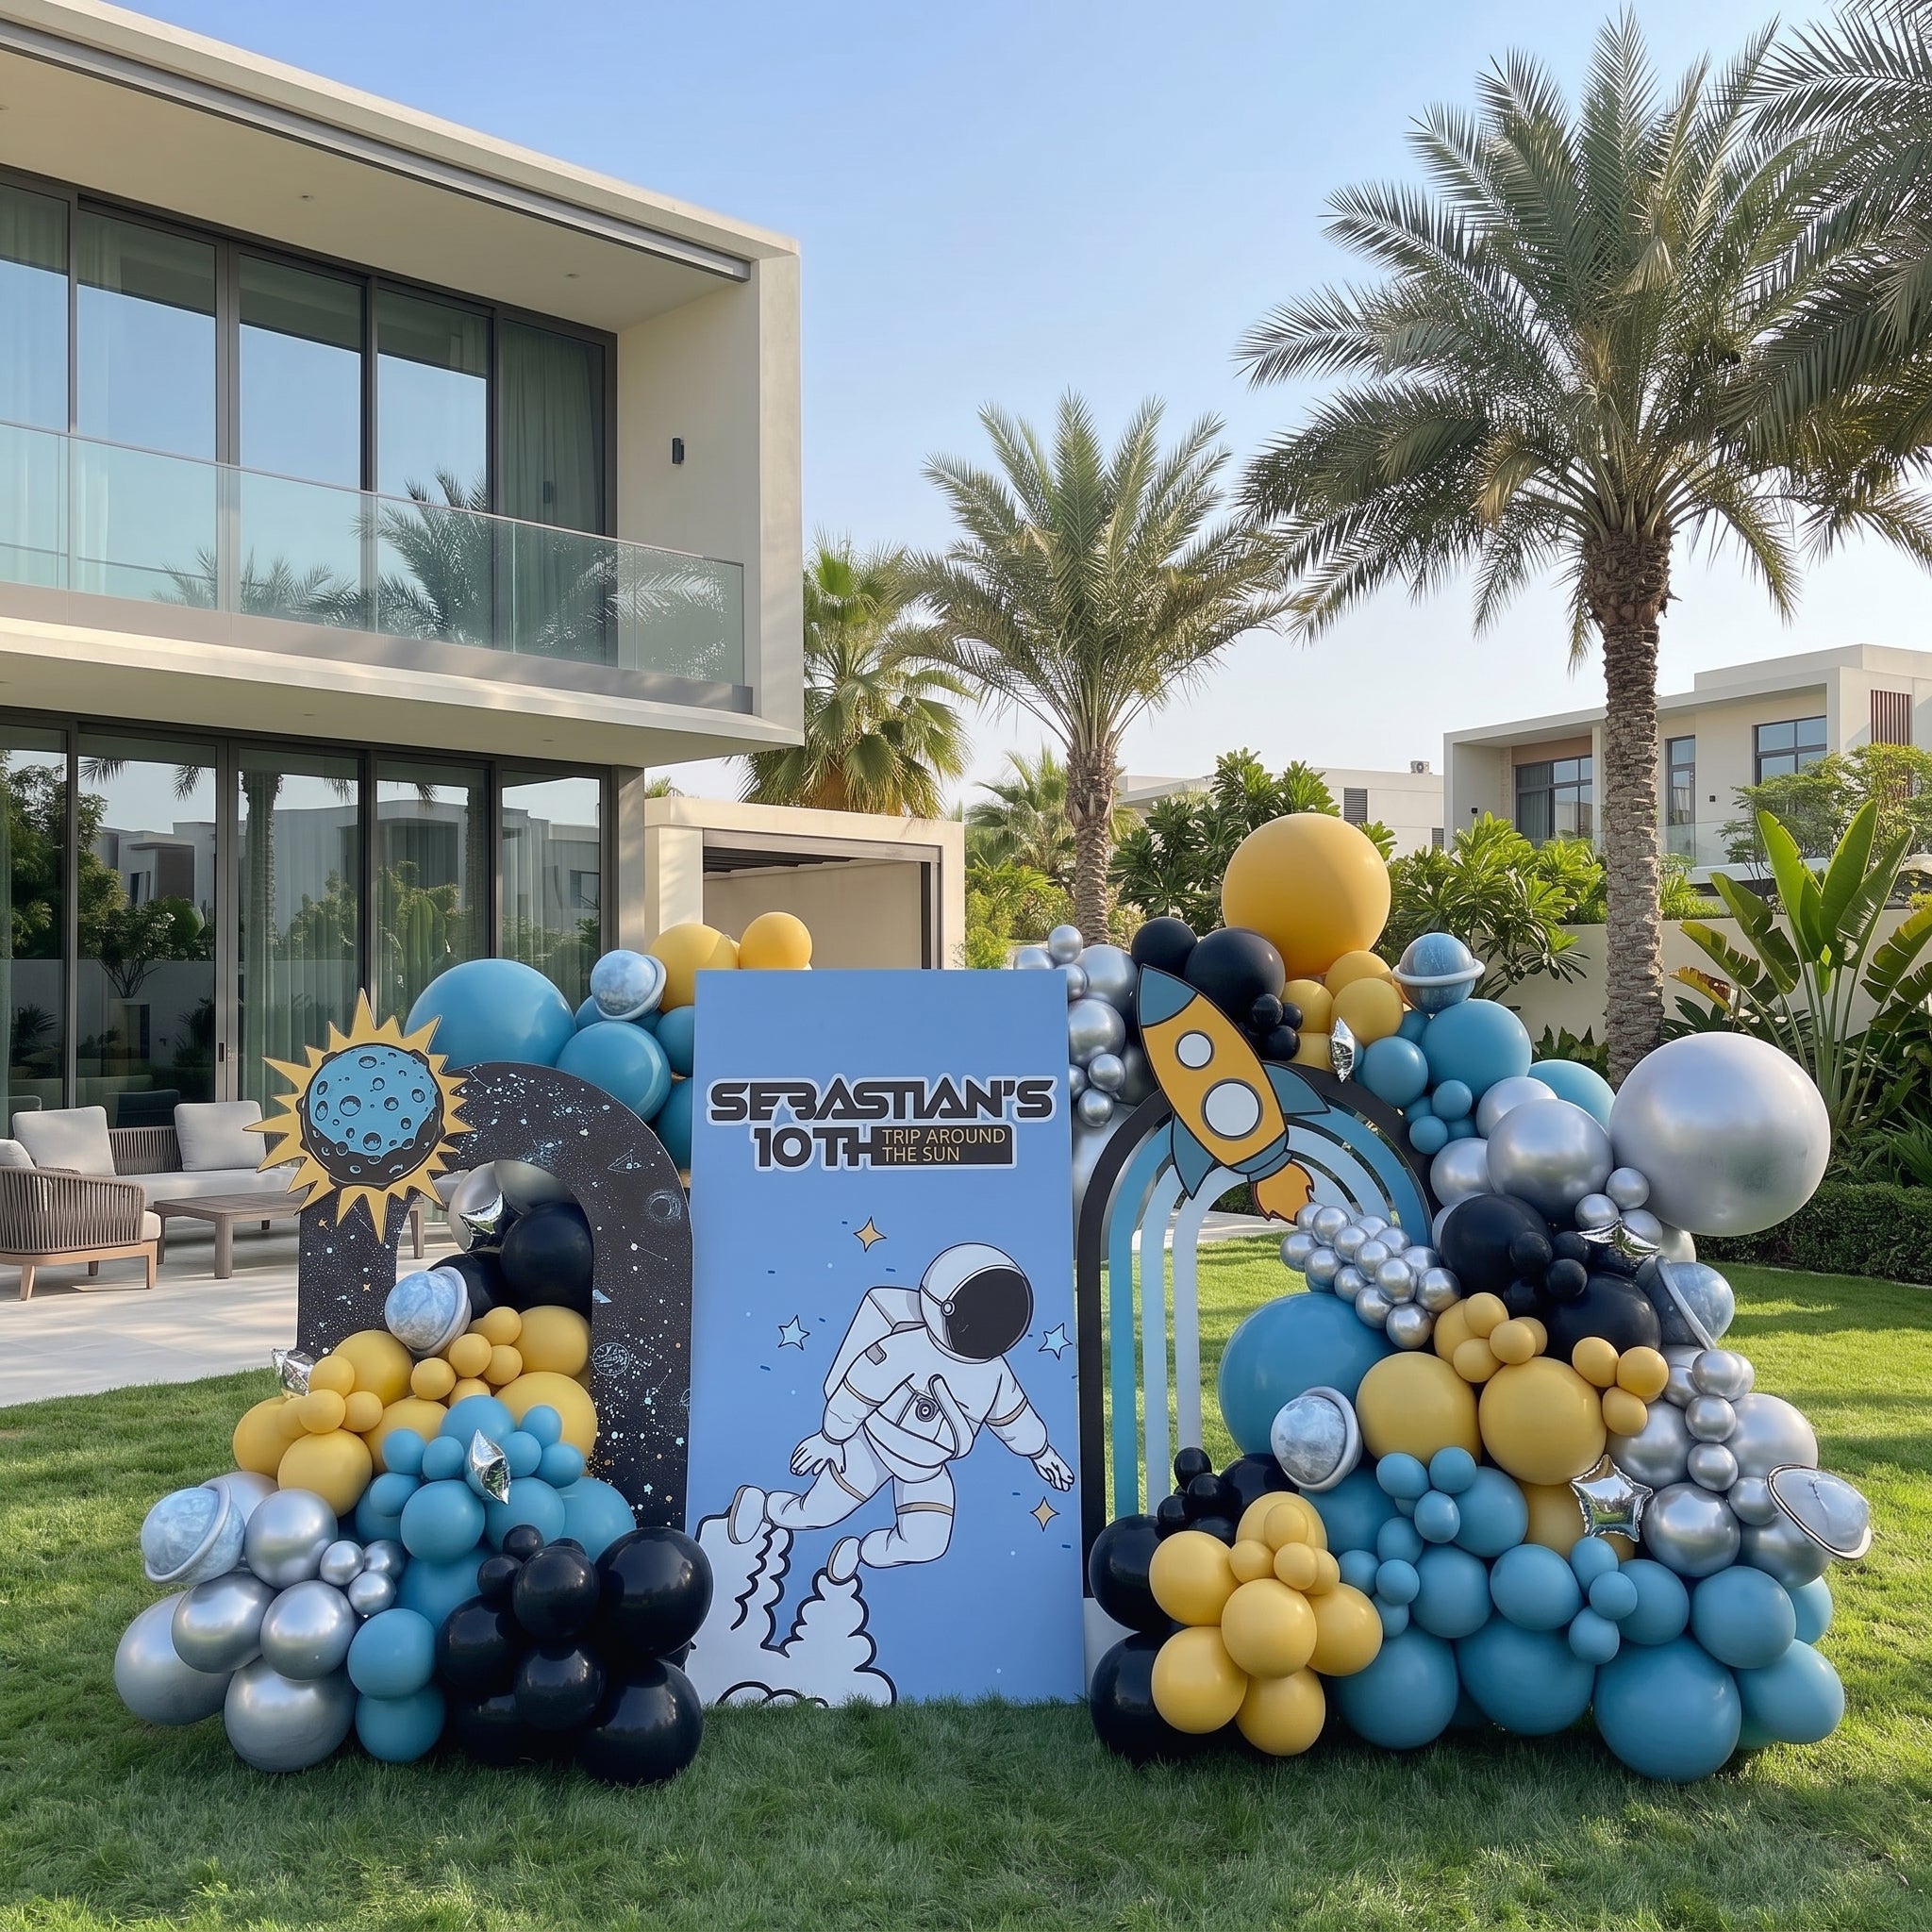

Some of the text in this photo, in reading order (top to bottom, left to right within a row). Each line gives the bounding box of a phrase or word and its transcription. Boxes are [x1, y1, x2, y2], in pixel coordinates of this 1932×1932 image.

[709, 1076, 1056, 1122] SEBASTIAN'S
[754, 1126, 874, 1168] 10TH
[881, 1128, 1006, 1145] TRIP AROUND
[881, 1146, 960, 1162] THE SUN
